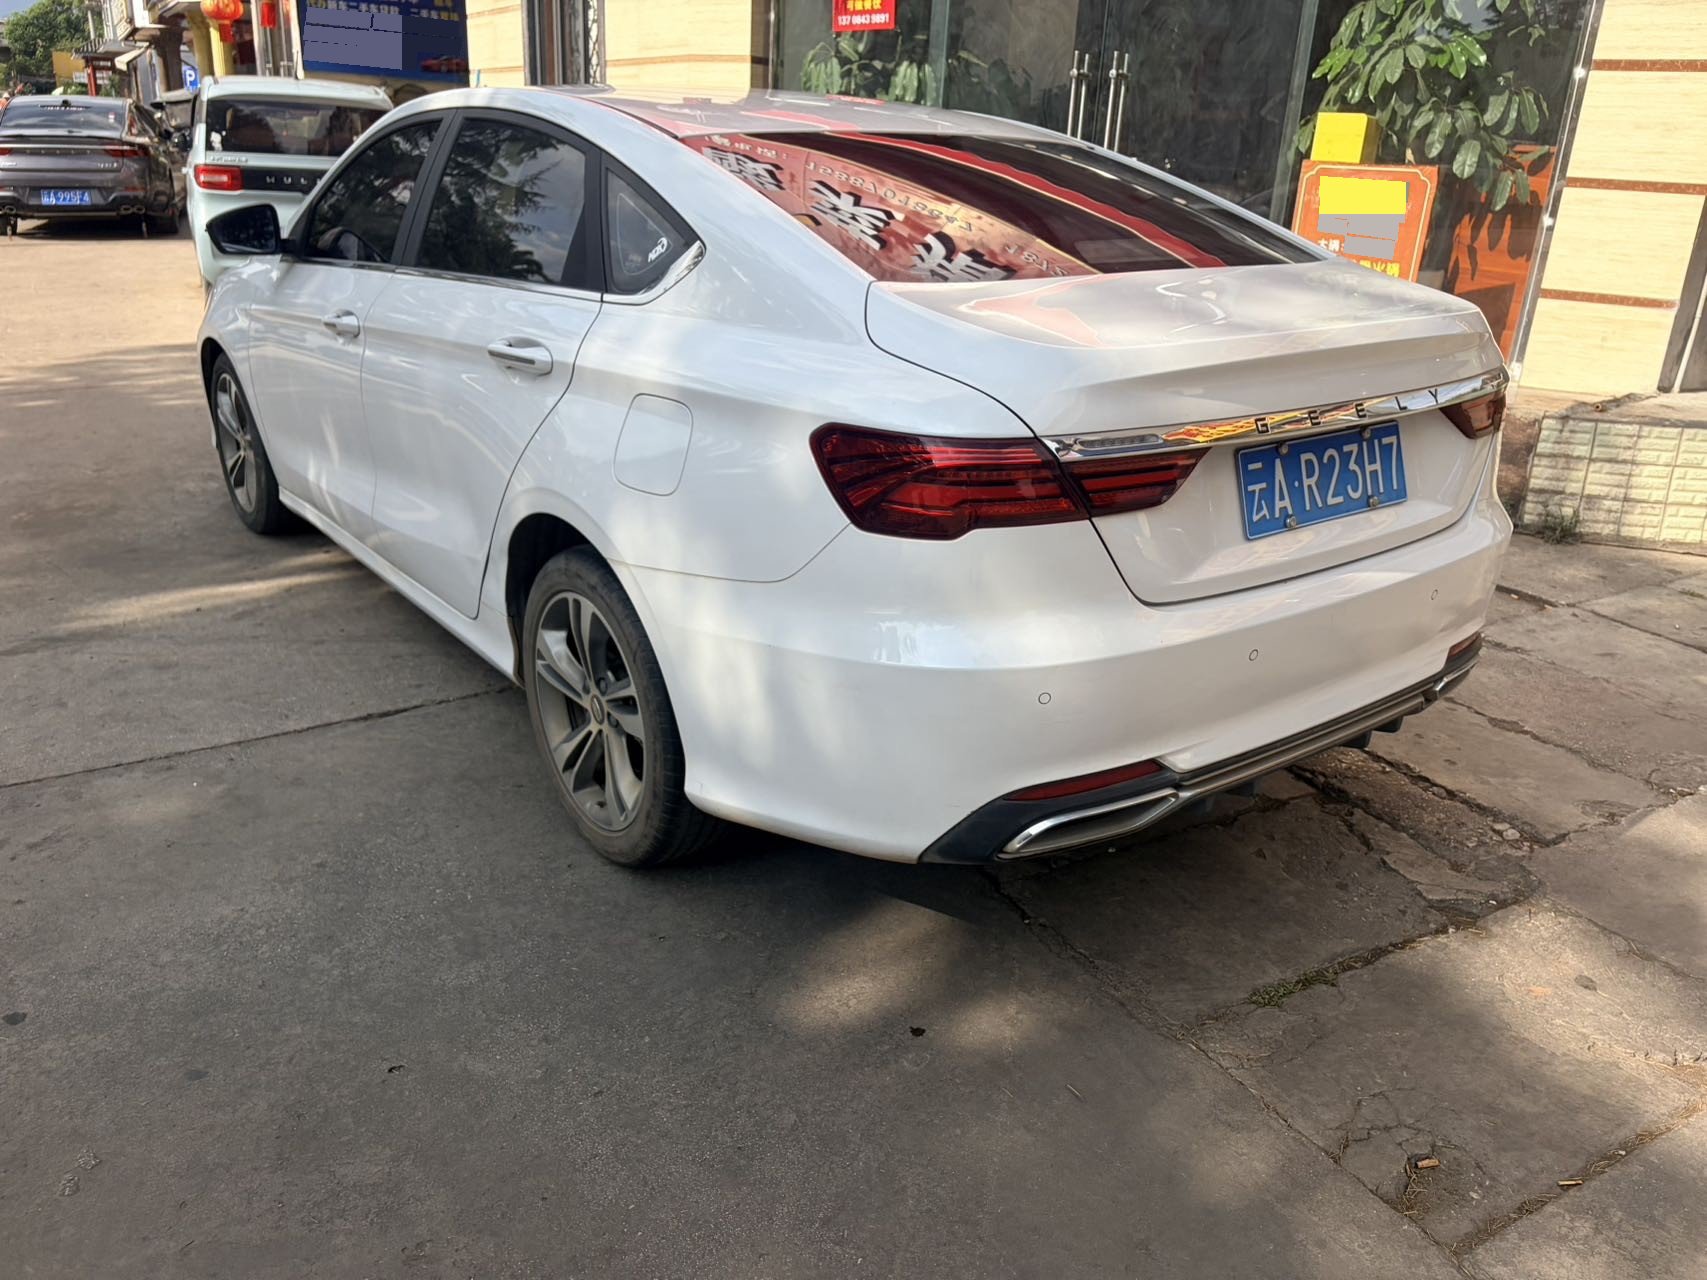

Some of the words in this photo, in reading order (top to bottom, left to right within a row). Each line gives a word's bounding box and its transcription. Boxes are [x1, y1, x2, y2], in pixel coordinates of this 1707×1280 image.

[838, 15, 850, 26] 137
[185, 69, 196, 88] P
[1255, 388, 1439, 434] GEELY
